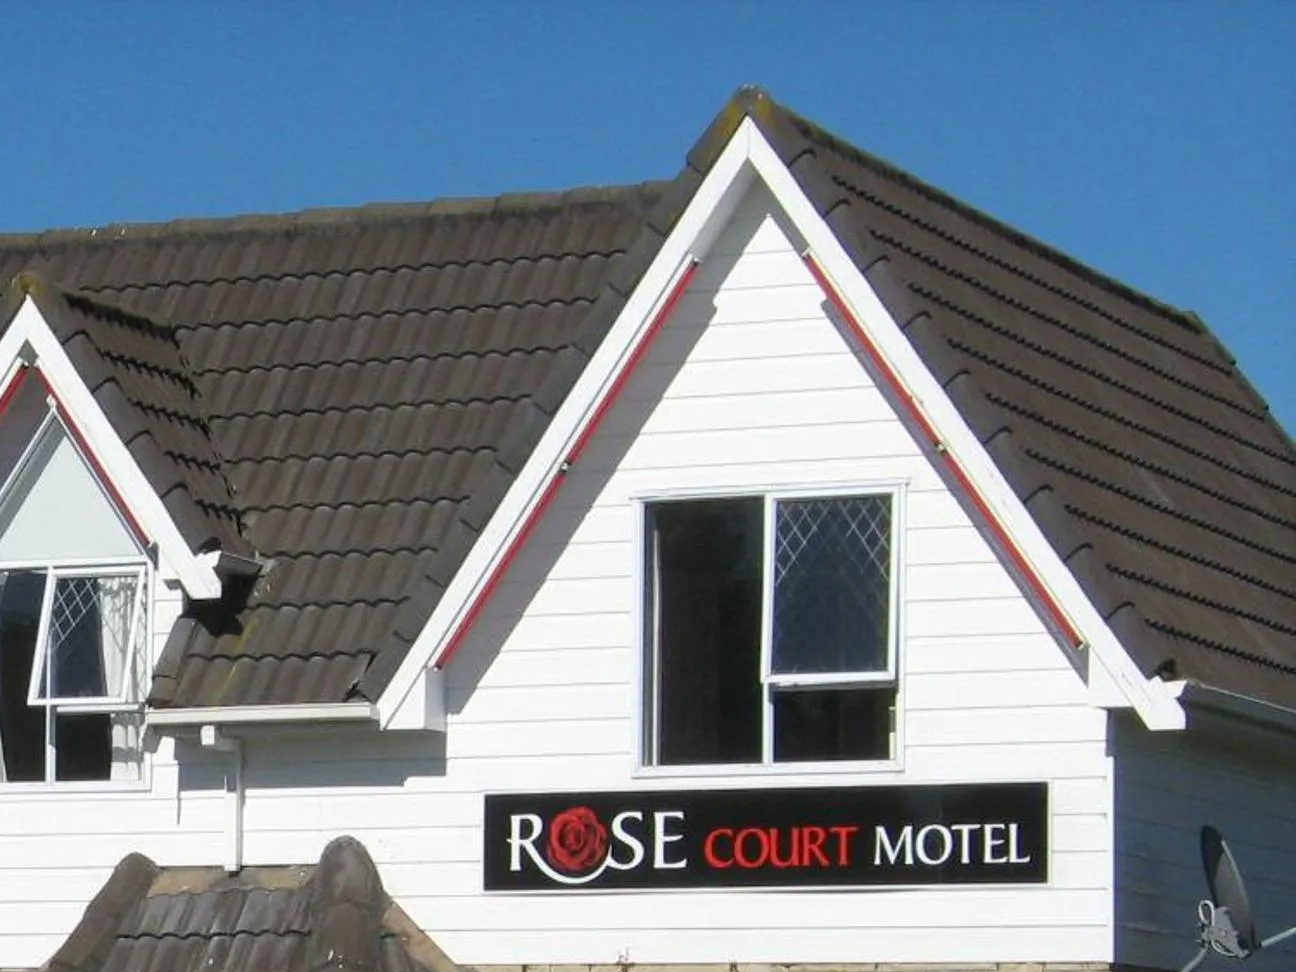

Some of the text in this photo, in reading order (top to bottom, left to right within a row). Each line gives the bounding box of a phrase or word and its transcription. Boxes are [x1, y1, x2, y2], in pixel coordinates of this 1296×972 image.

[506, 806, 1031, 884] ROSE COURT MOTEL
